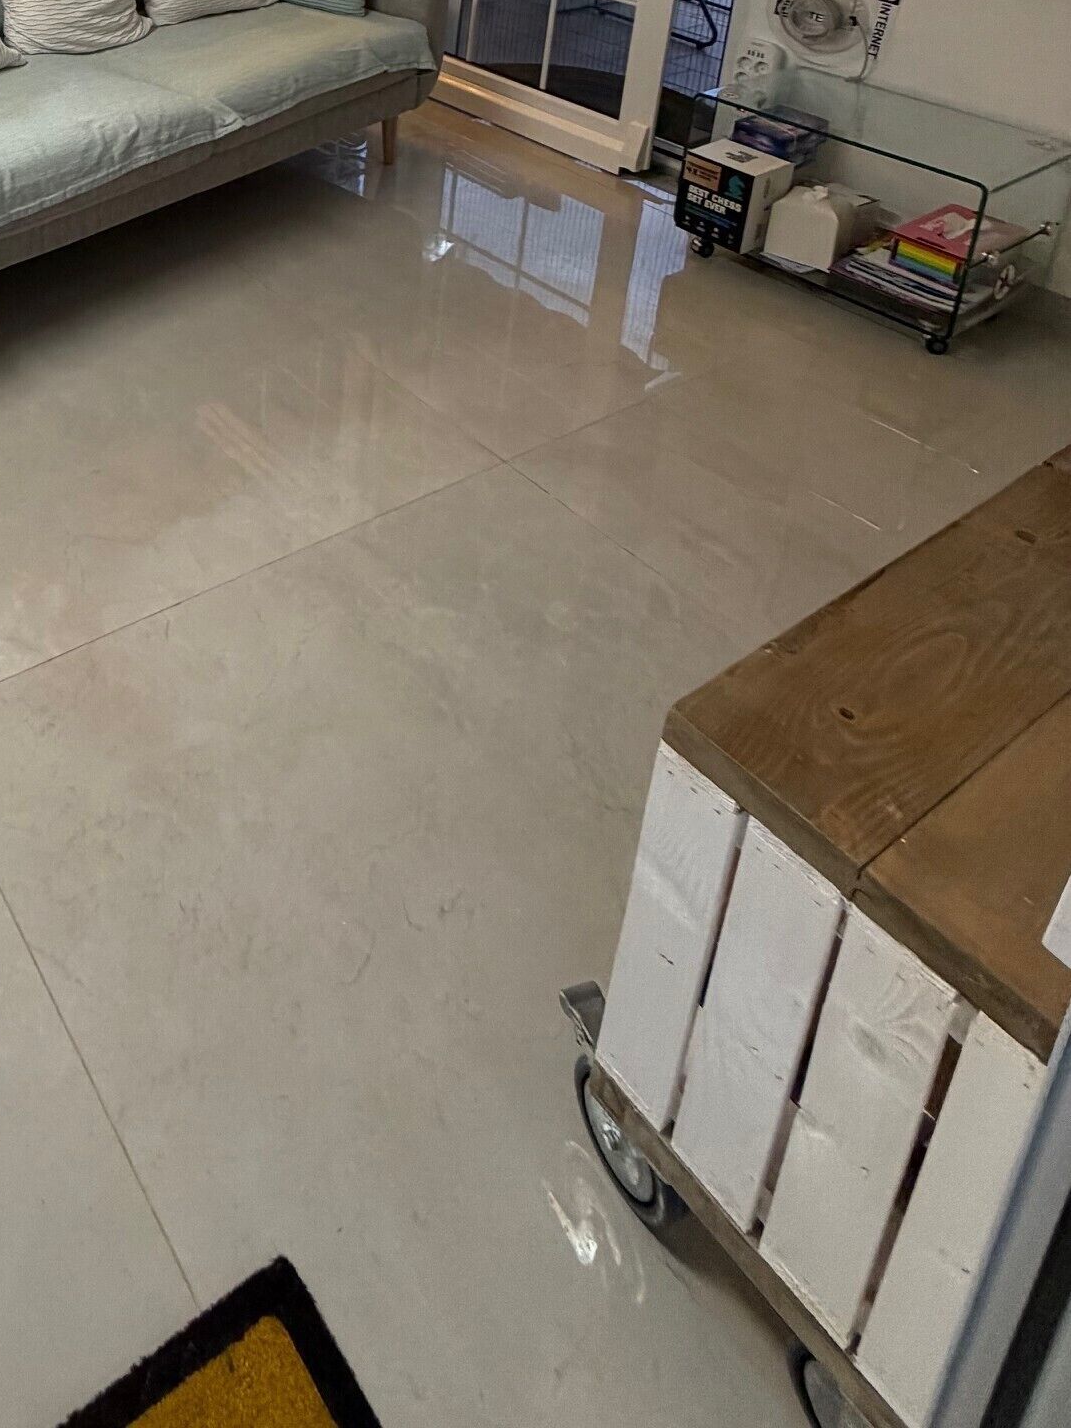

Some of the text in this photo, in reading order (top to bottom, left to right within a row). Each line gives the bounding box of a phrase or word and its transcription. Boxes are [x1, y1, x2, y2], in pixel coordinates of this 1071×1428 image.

[867, 2, 892, 60] INTERNET
[687, 192, 726, 215] SET EVER
[688, 184, 742, 213] BEST CHESS
